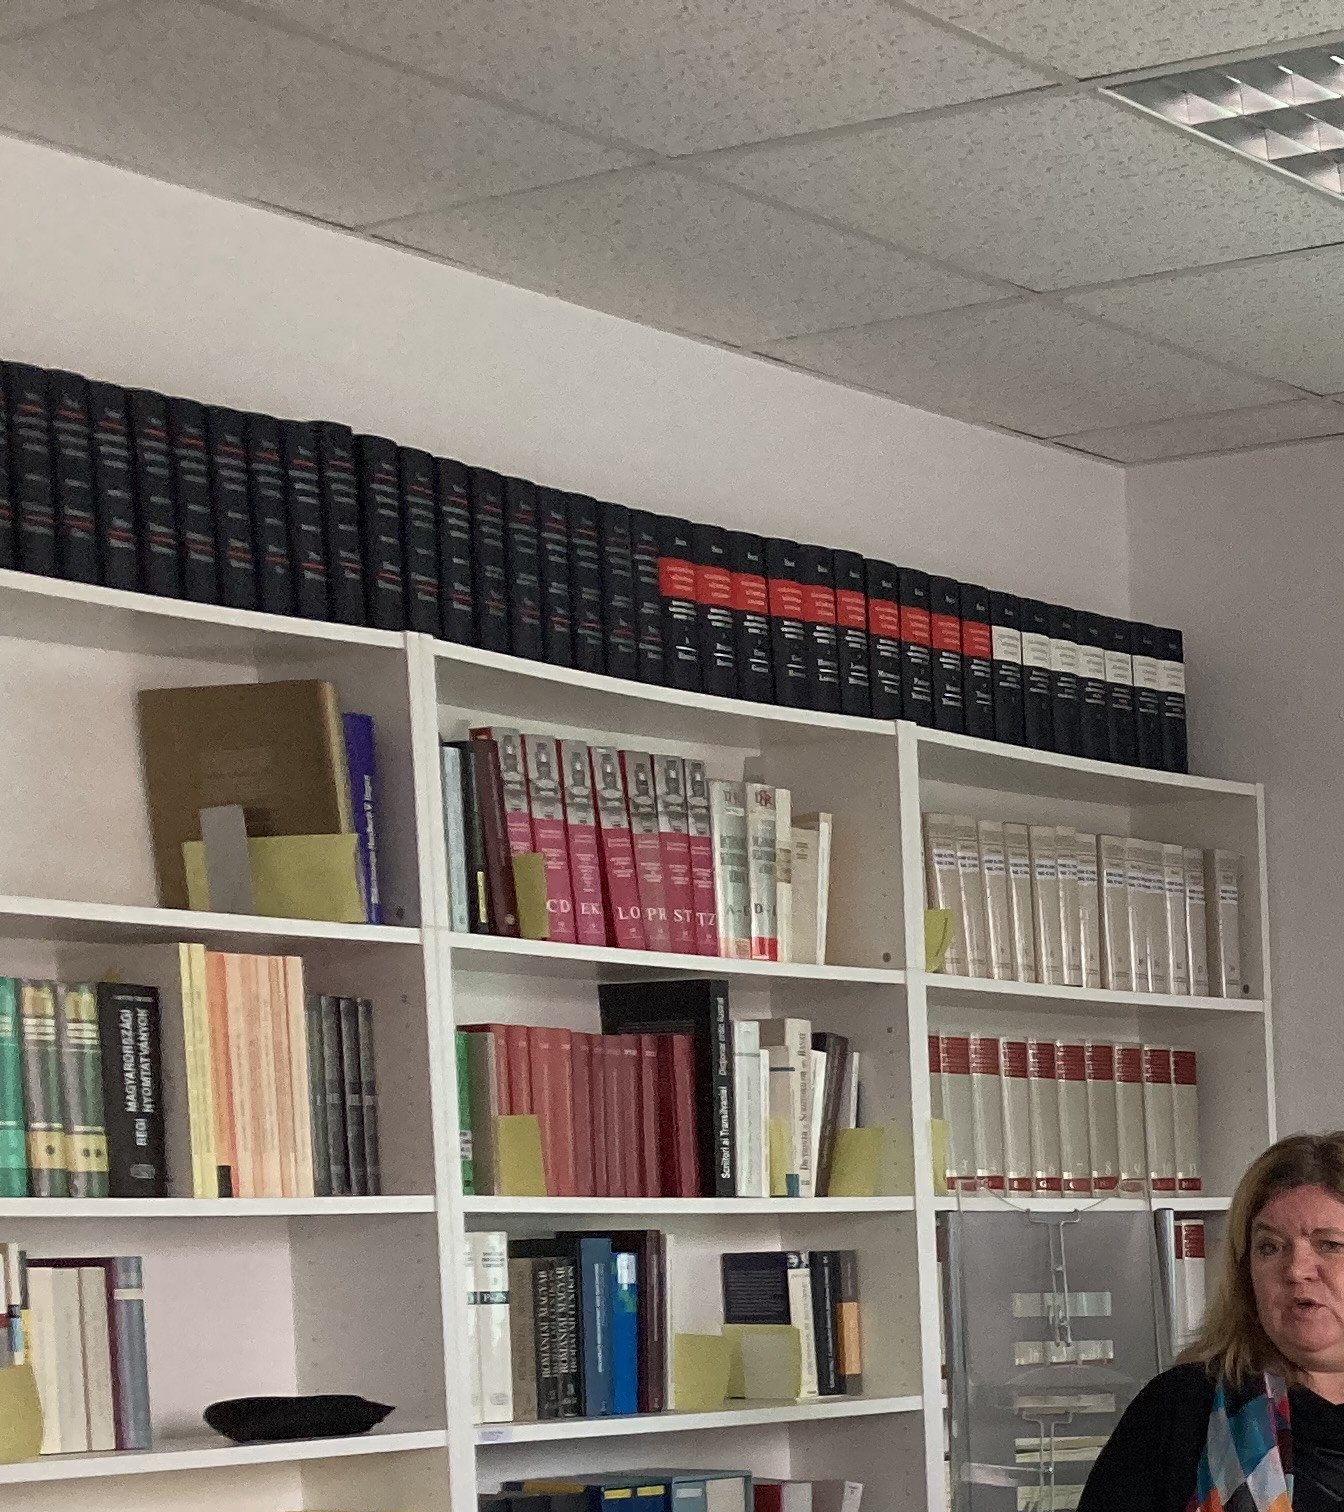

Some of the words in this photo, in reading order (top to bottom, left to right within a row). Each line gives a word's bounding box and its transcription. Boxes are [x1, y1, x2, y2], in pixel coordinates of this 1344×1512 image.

[546, 899, 572, 913] CD
[617, 906, 641, 920] LO
[673, 909, 693, 923] ST
[696, 912, 718, 928] TZ
